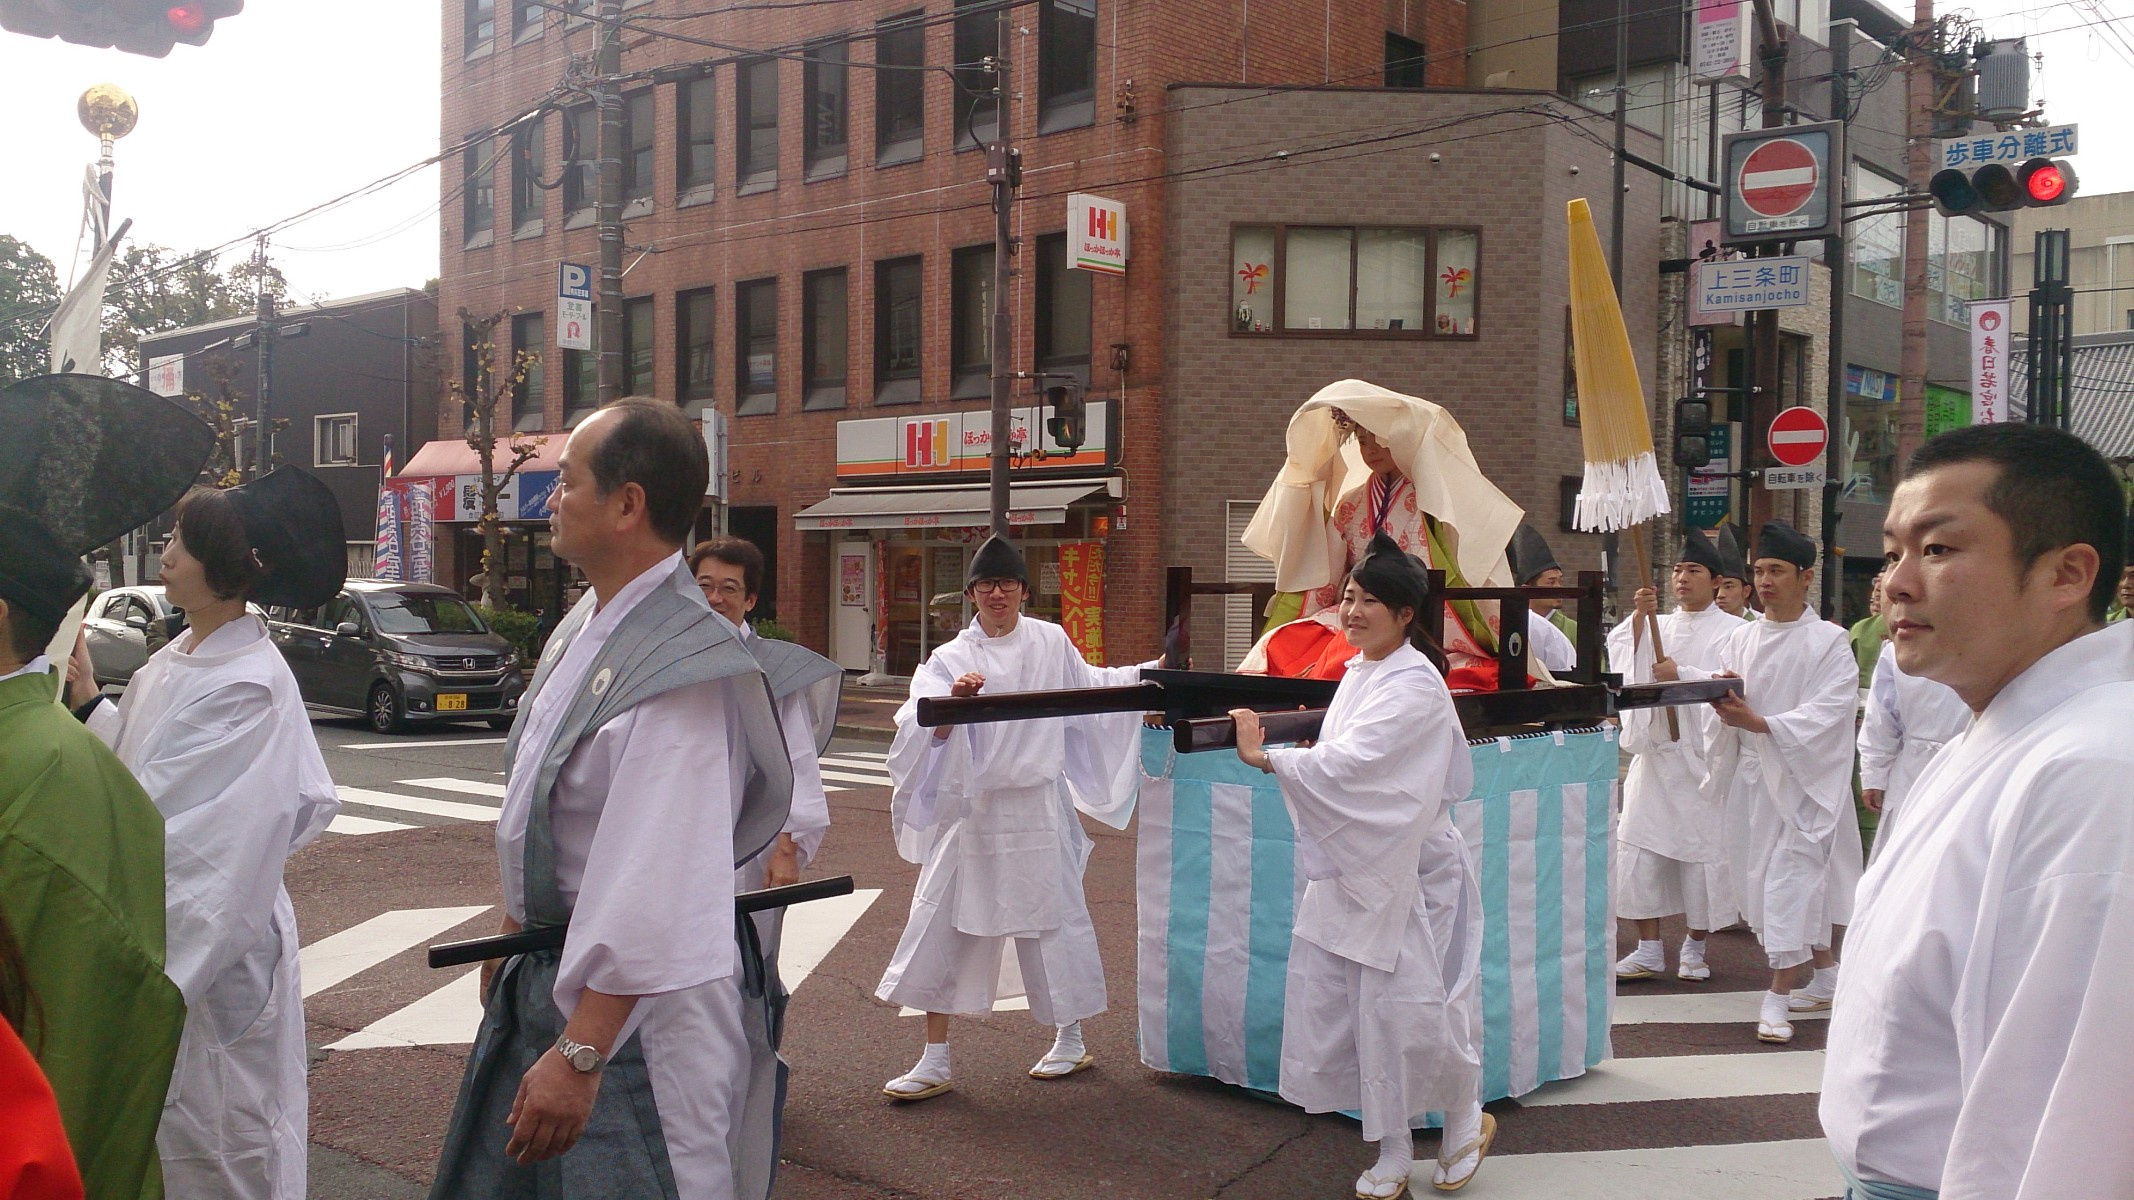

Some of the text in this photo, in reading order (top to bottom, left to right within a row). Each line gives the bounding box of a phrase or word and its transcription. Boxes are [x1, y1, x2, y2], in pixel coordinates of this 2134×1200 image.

[1946, 128, 2074, 166] 歩車分離式
[563, 265, 586, 295] P
[1708, 265, 1801, 290] 上三条町
[1706, 289, 1800, 305] Kamisanjocho
[1768, 472, 1823, 485] 自転車を除く
